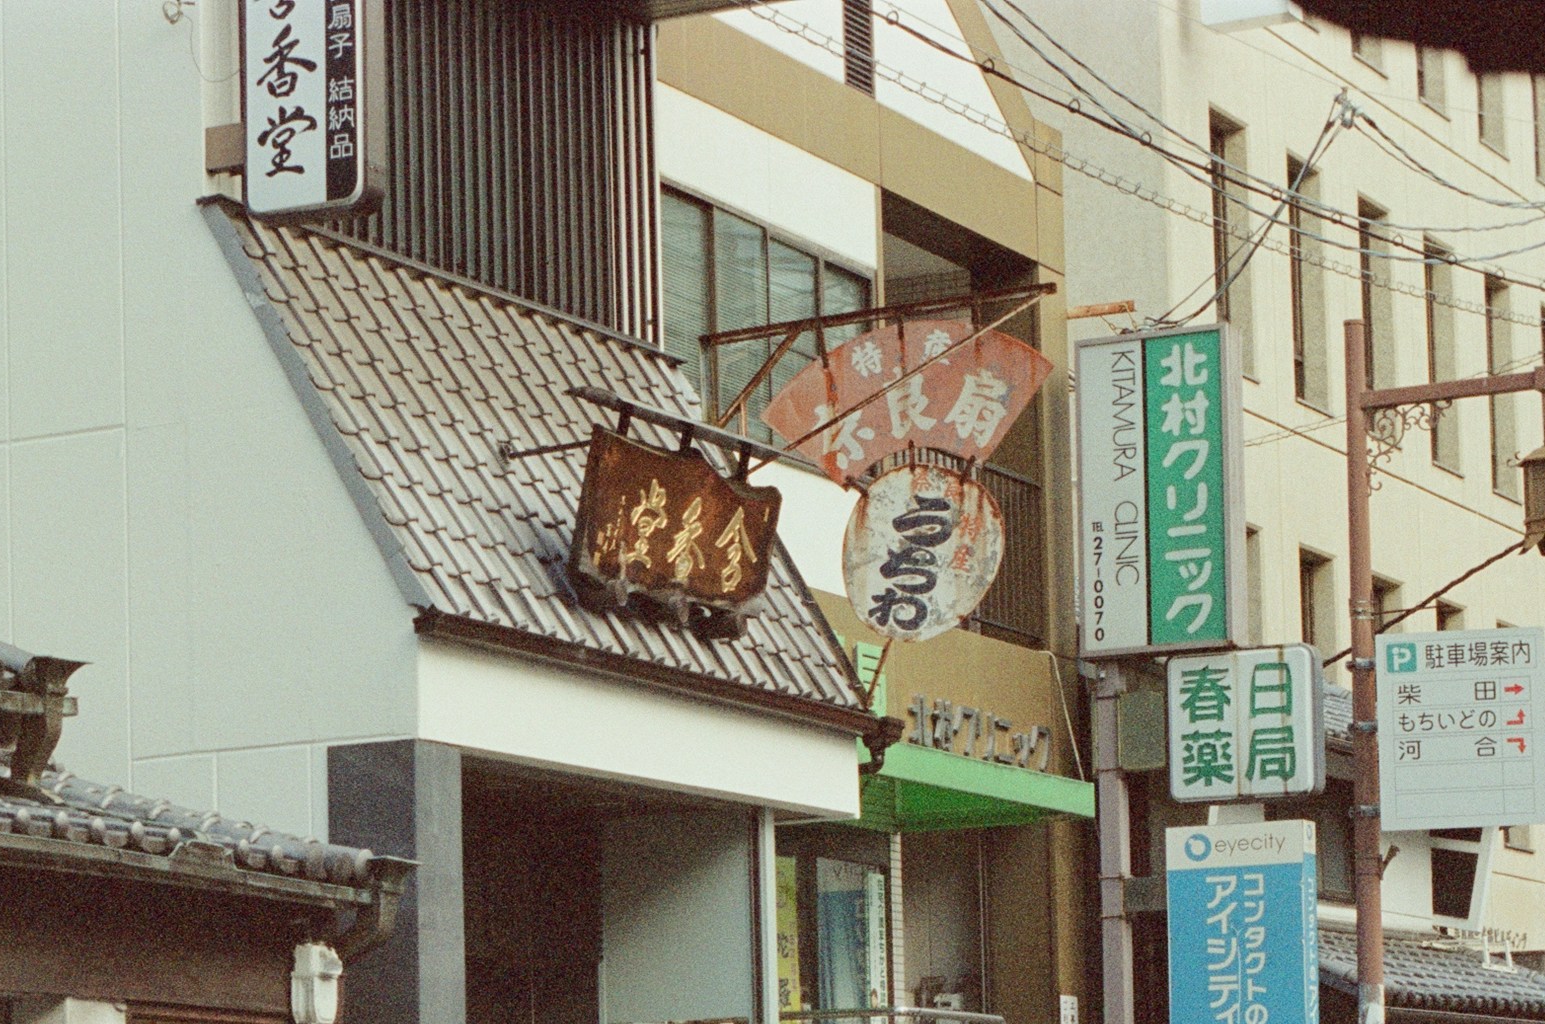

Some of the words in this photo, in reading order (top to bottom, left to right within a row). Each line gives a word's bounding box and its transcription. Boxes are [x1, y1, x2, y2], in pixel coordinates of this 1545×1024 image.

[328, 76, 355, 159] 結納品
[813, 367, 1008, 469] 奈良扇
[1111, 350, 1137, 482] KITAMURA
[1092, 522, 1104, 533] TEL
[1159, 342, 1212, 634] 北村クリニック
[867, 494, 953, 631] うちわ
[1114, 501, 1139, 587] CLINIC
[1092, 536, 1105, 641] 27-0070
[1425, 640, 1531, 669] 駐車場案内
[907, 693, 1052, 773] 北村クリニック
[1398, 709, 1497, 732] もちいどの
[1214, 834, 1286, 857] eyecity
